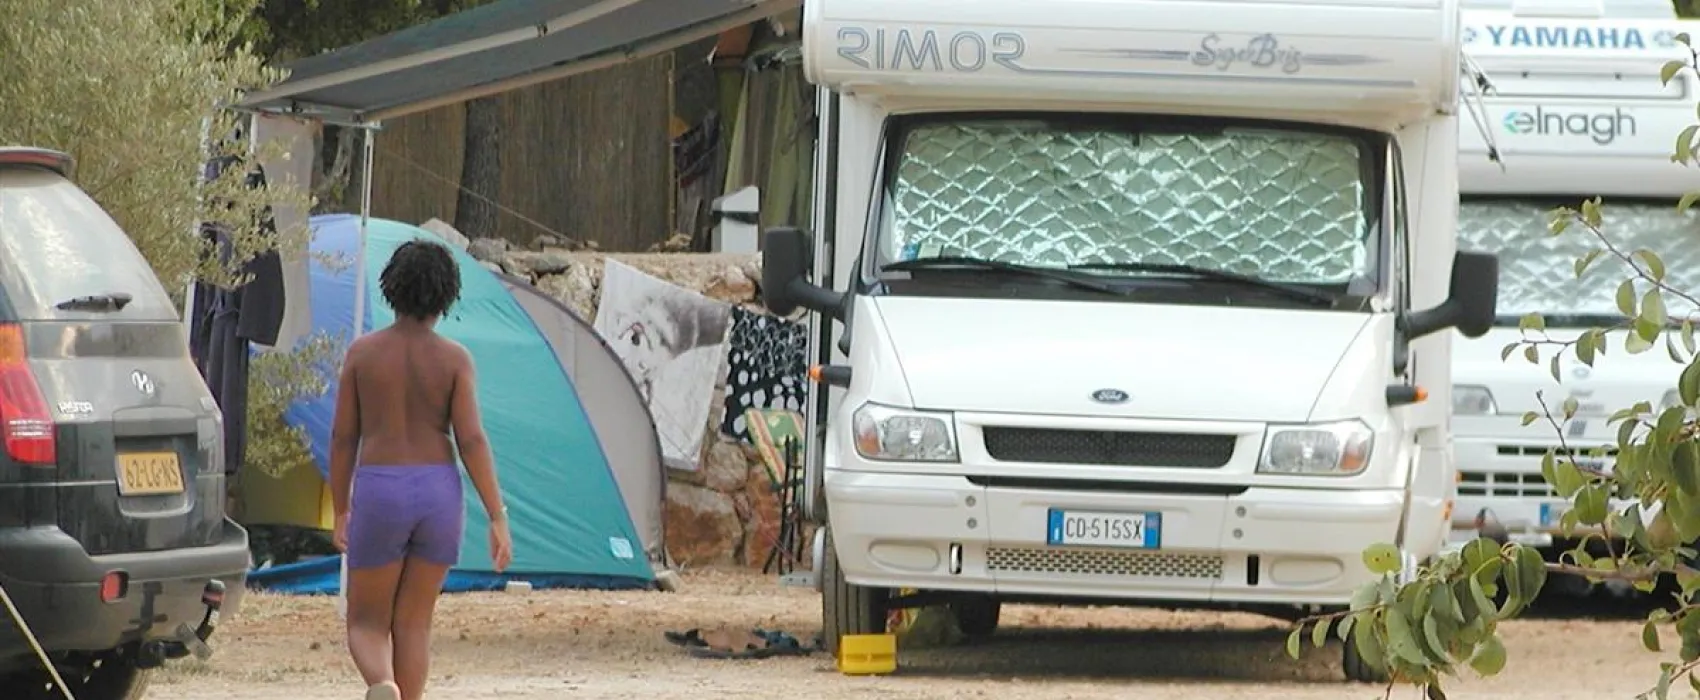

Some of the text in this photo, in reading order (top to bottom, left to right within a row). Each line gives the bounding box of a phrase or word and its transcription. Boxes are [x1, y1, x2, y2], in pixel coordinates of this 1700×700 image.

[836, 26, 1026, 73] RIMOR
[1486, 24, 1646, 49] YAMAHA
[1503, 104, 1636, 145] elnagh
